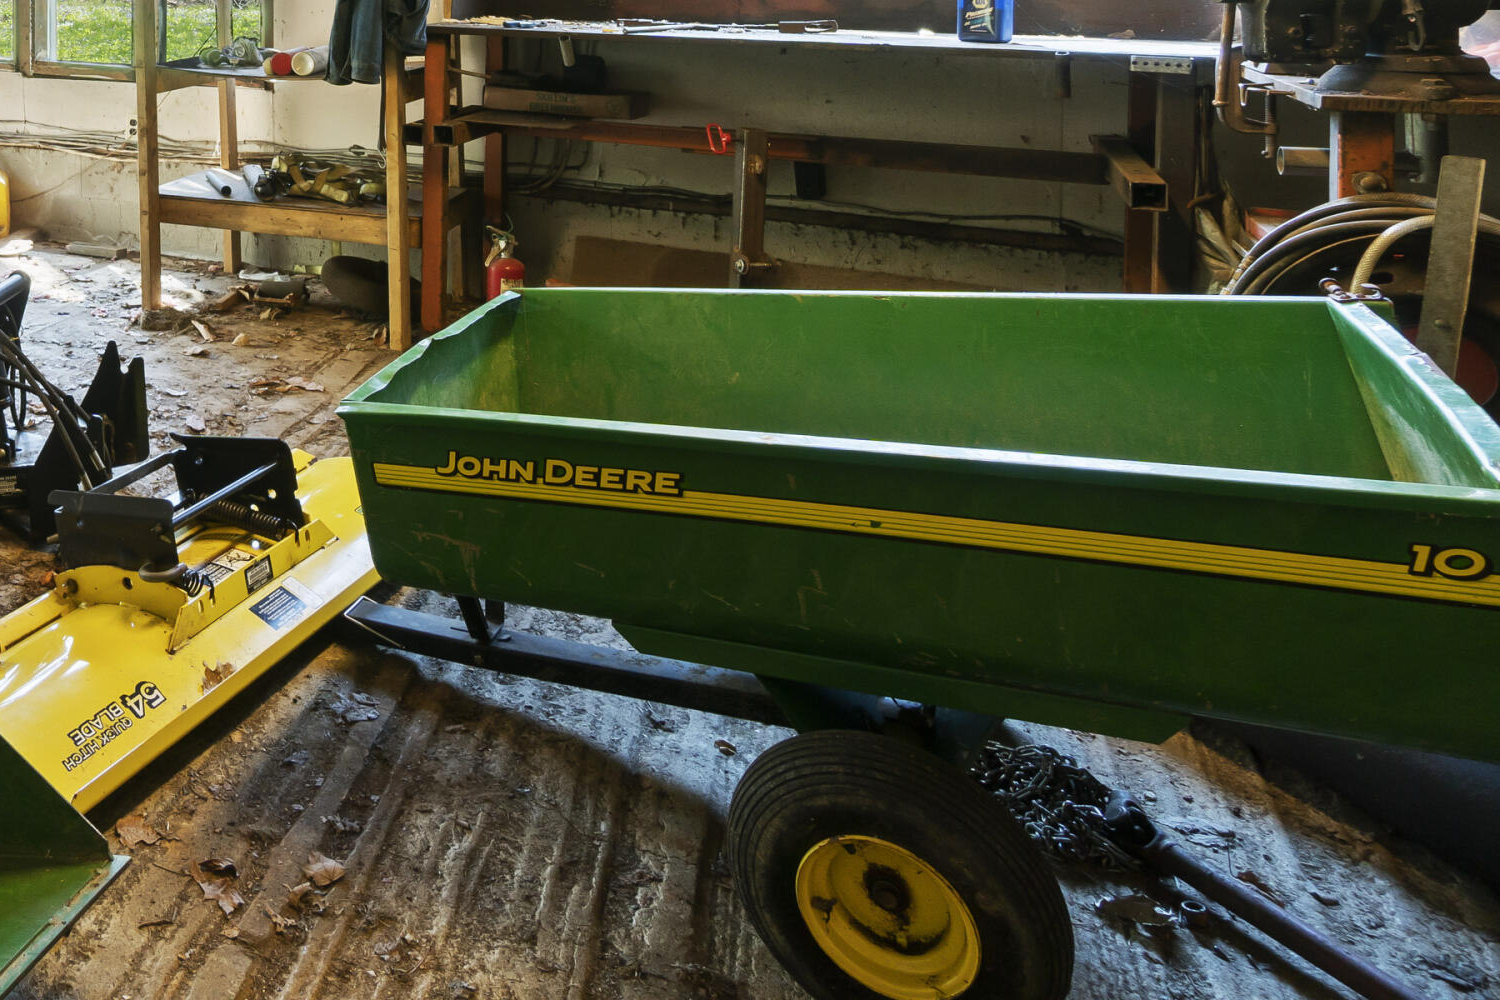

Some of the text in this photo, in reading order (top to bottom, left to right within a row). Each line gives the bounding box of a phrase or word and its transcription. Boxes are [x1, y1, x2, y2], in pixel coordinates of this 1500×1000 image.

[436, 451, 681, 495] JOHN DEERE
[1411, 544, 1487, 578] 10
[119, 681, 167, 719] 54
[62, 717, 133, 772] QUICK HITCH
[67, 701, 125, 746] BLADE
